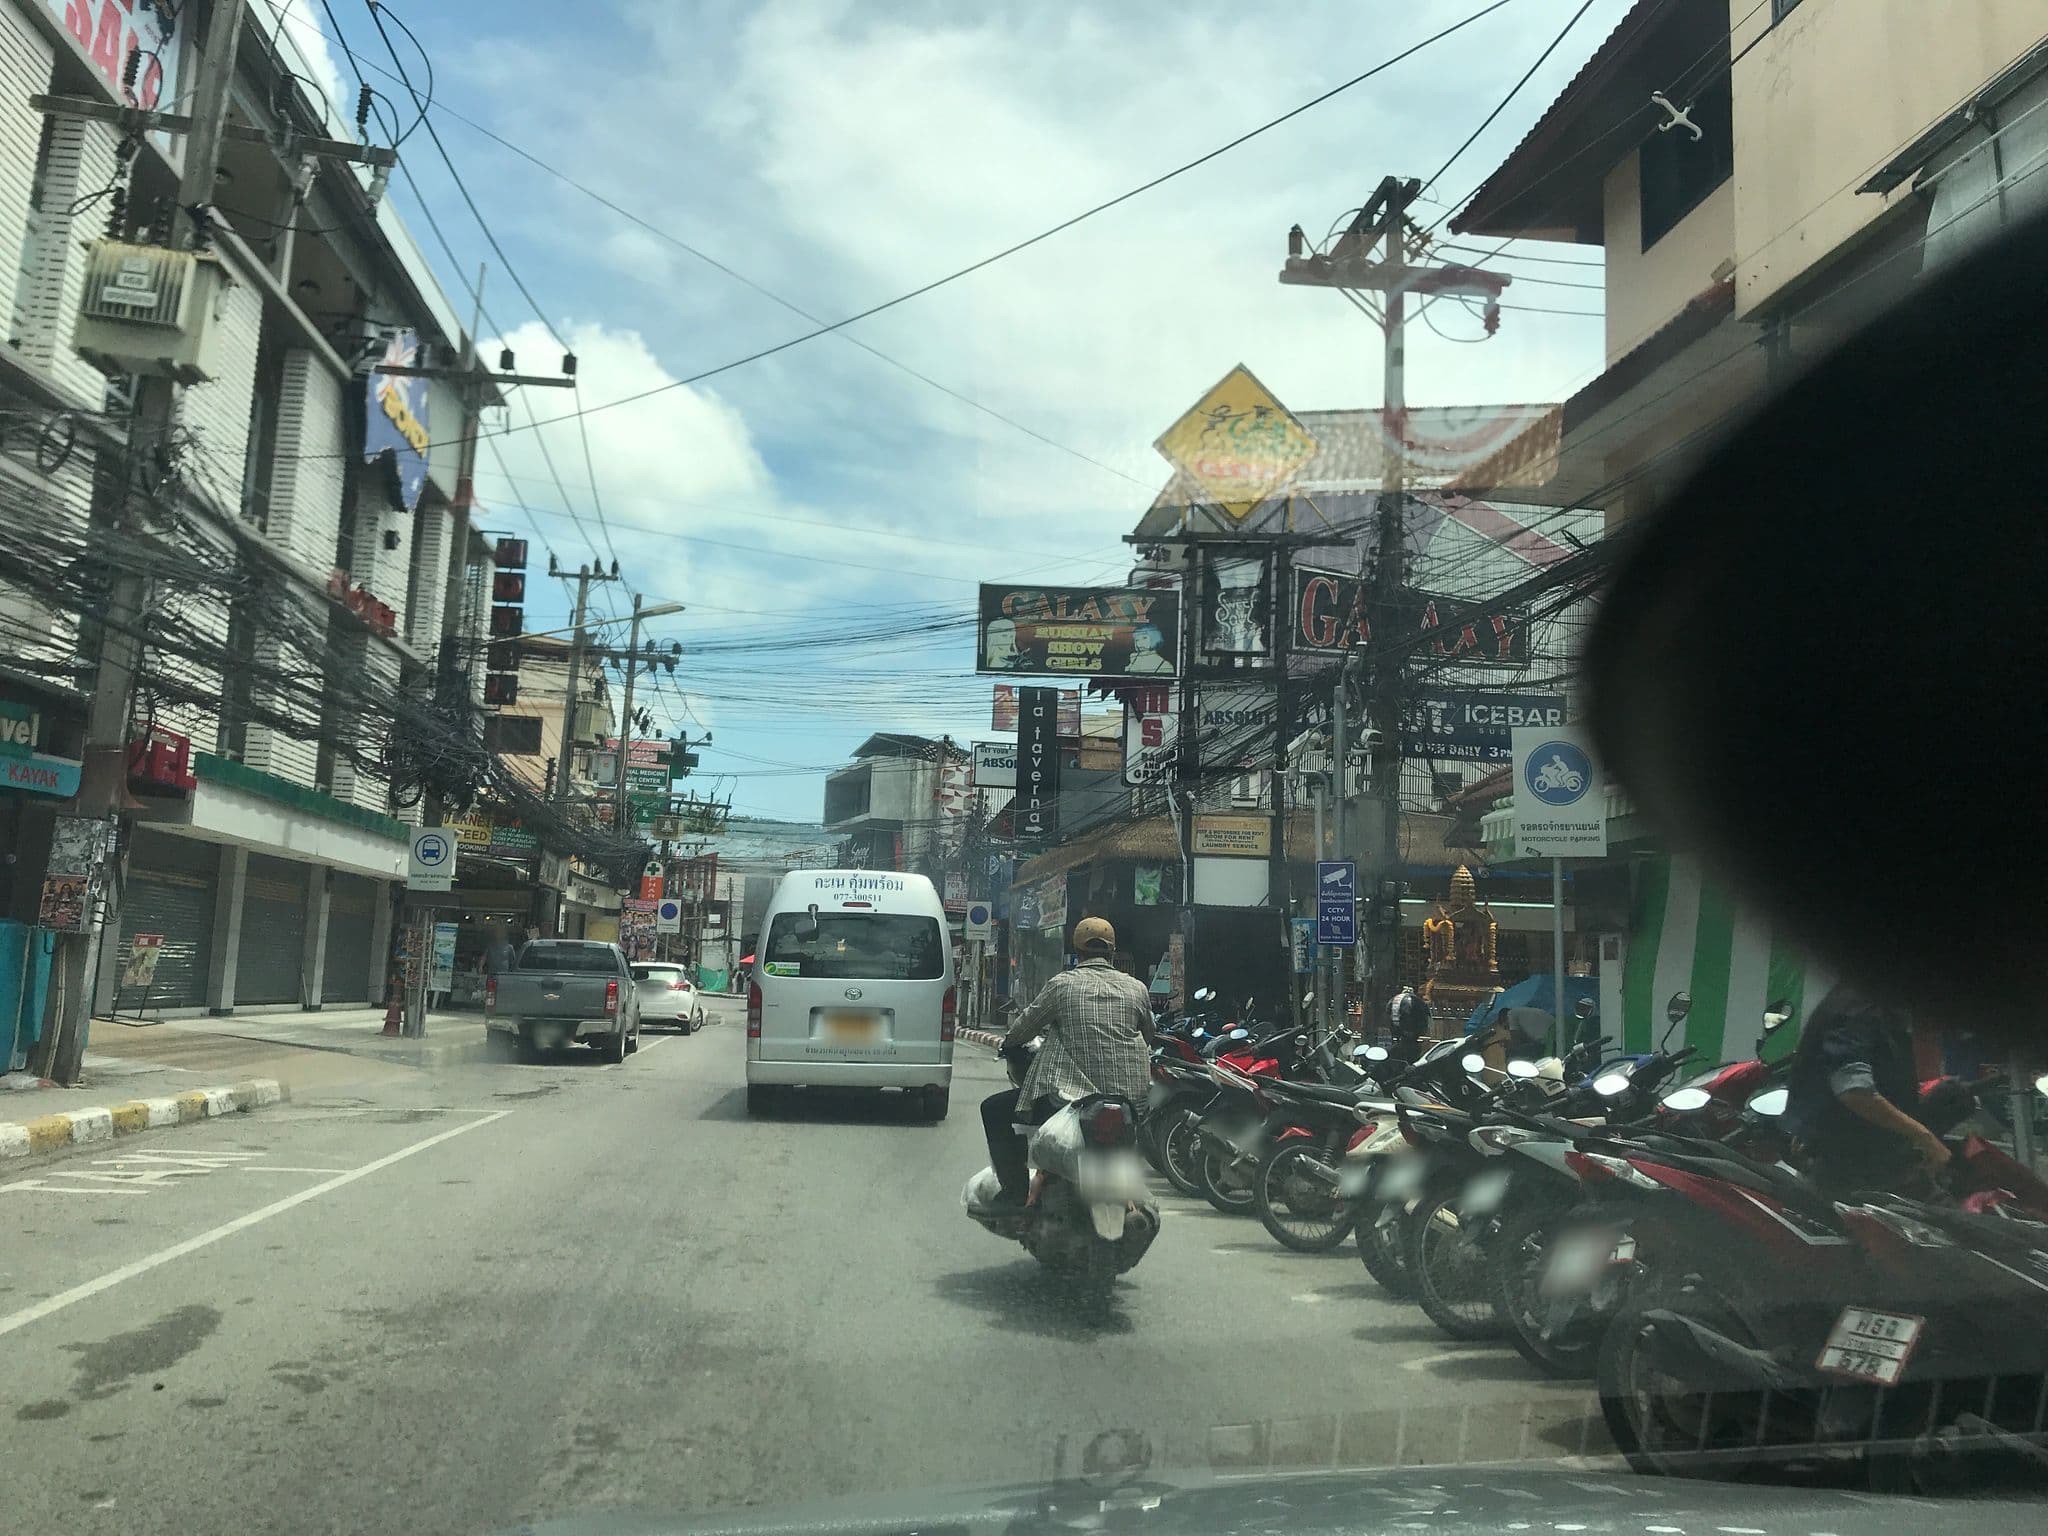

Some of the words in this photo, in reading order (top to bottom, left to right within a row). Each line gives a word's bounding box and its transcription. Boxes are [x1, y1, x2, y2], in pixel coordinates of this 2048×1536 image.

[1001, 591, 1156, 623] GALAXY
[1301, 577, 1519, 660] GAAXY
[1034, 625, 1114, 641] RUSSIAN
[1047, 641, 1105, 655] SHOW
[1045, 656, 1103, 671] GIRLS
[1464, 703, 1562, 727] ICEBAR
[9, 762, 59, 788] KAYAK
[638, 776, 661, 784] CENTER
[833, 893, 882, 902] 077-300511
